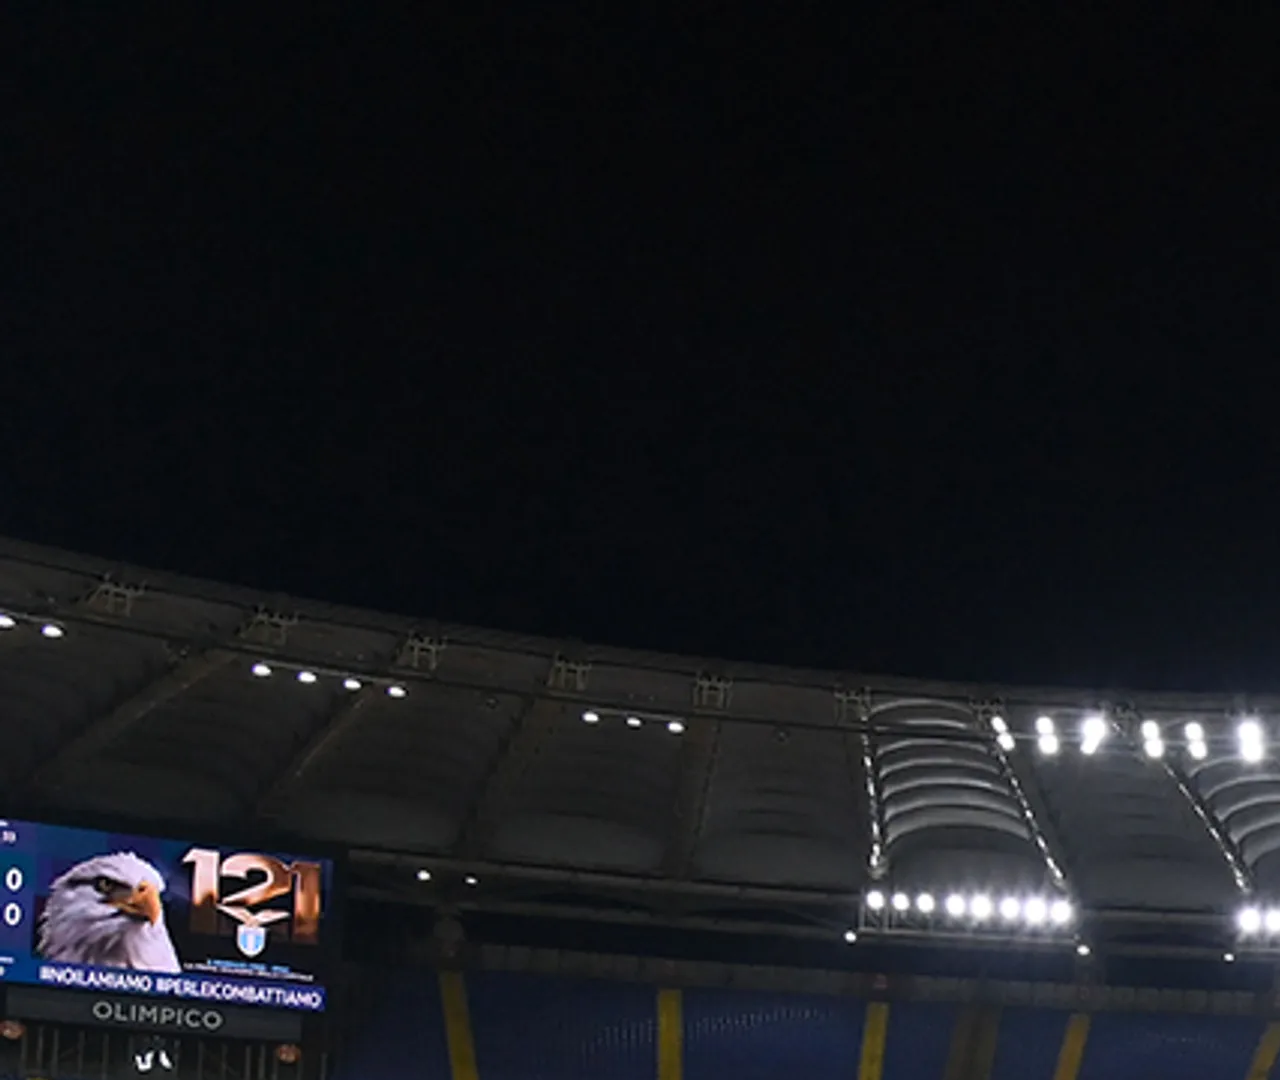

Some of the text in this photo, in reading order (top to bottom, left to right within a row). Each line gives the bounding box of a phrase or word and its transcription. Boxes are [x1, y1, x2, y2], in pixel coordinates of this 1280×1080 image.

[5, 867, 23, 891] 0
[183, 848, 321, 920] 121
[4, 903, 21, 926] 0
[92, 1001, 223, 1029] OLIMPICO
